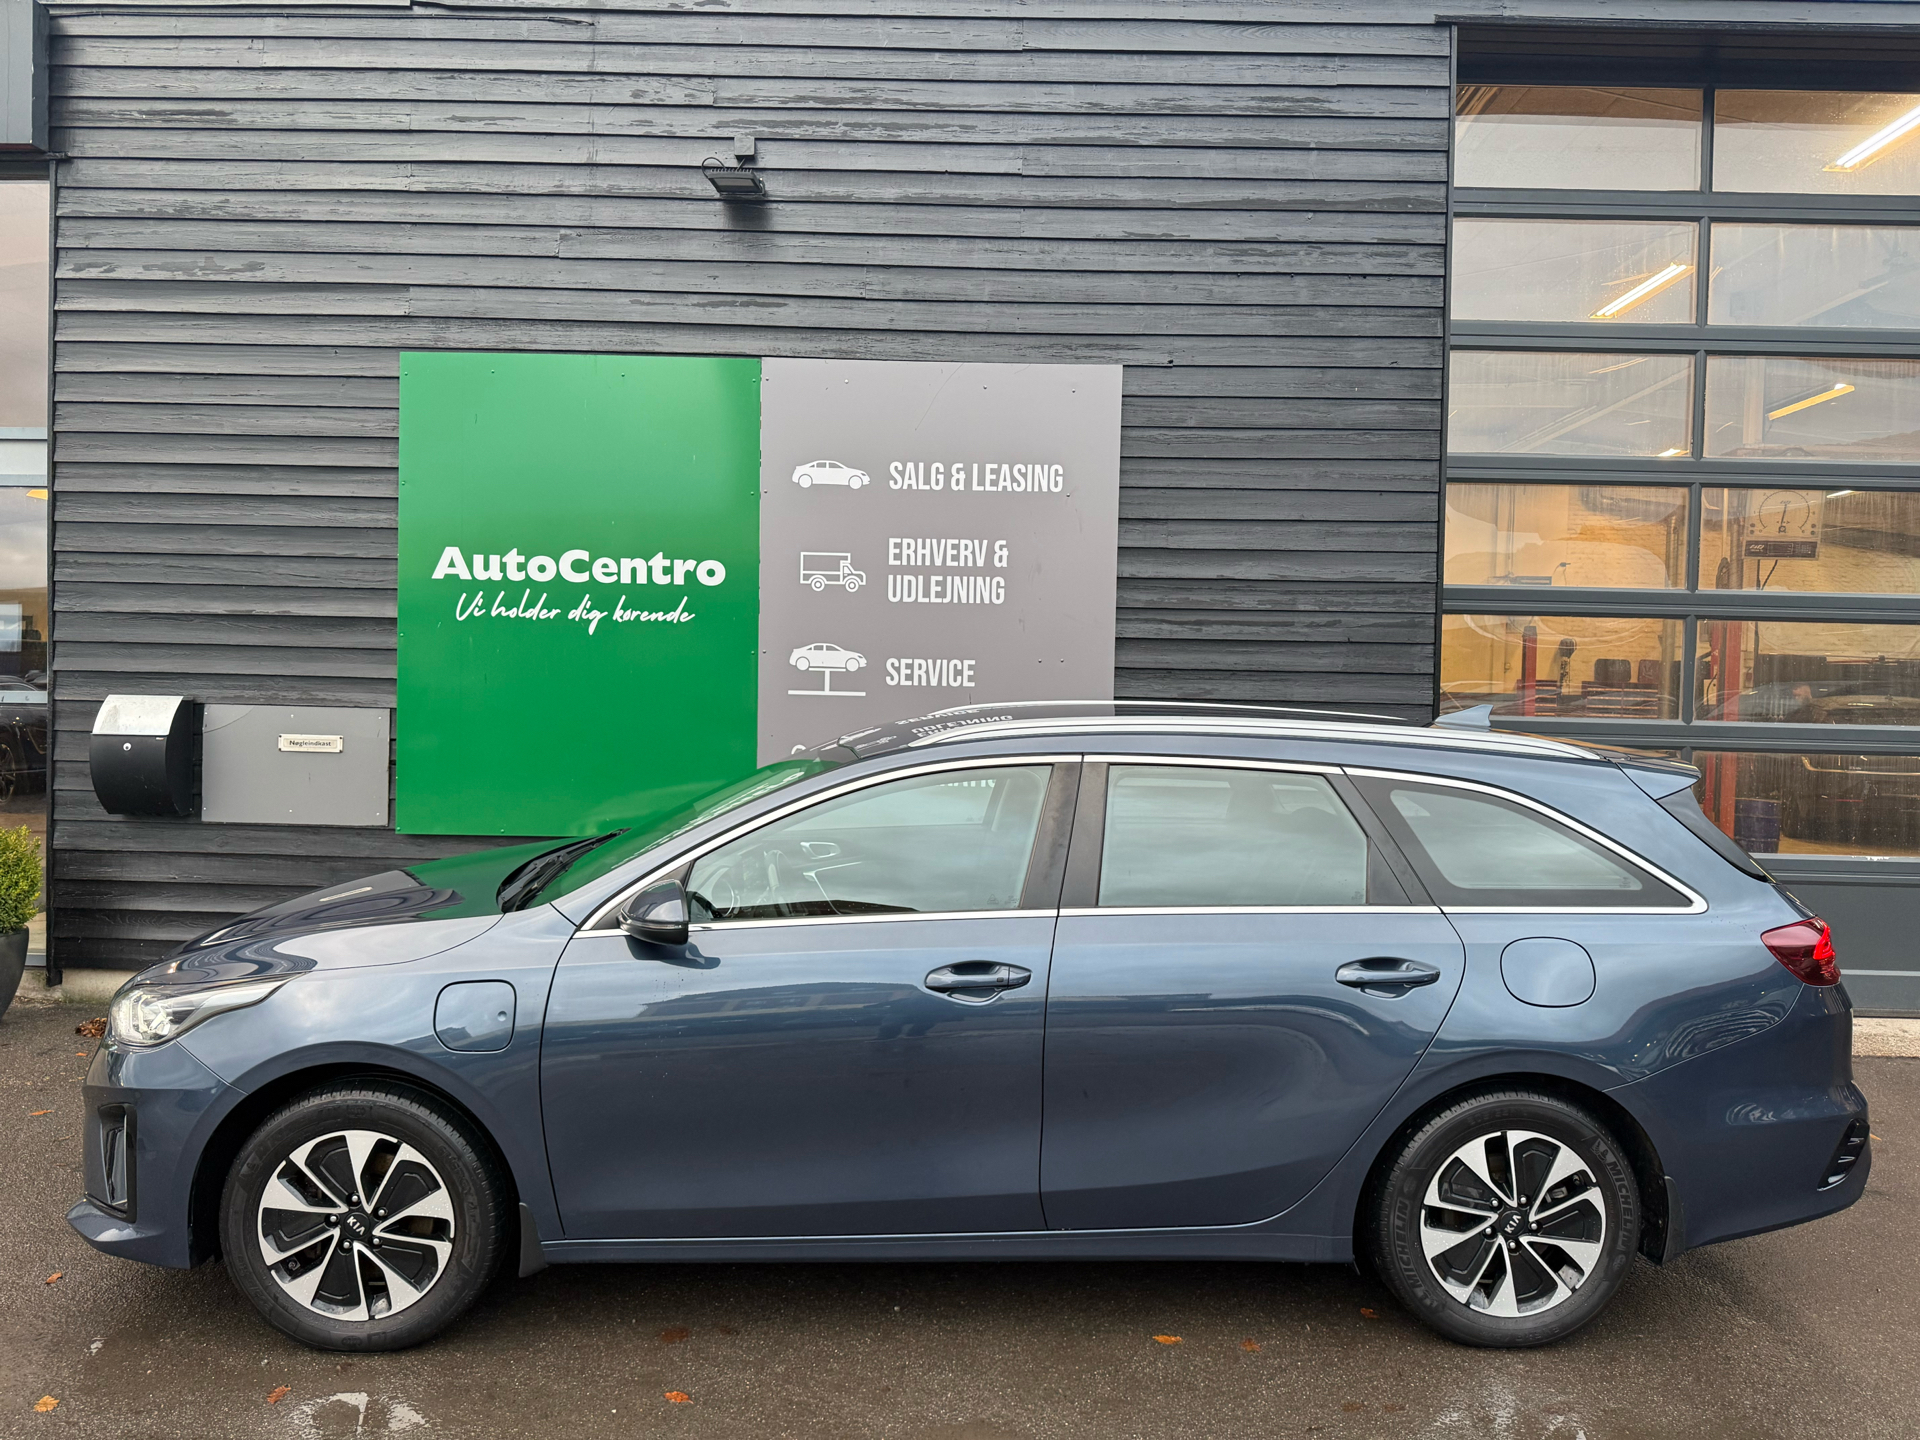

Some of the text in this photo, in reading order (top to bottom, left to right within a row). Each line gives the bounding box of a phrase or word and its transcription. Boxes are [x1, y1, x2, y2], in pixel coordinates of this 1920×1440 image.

[889, 461, 1063, 492] SALG & LEASING
[431, 546, 727, 586] AutoCentro
[888, 538, 1009, 567] ERHVERV &
[887, 575, 1005, 604] UDLEJNING
[456, 588, 695, 636] Vi holder dig kørende
[886, 658, 976, 687] SERVICE
[1607, 1160, 1633, 1251] MICHELIN
[347, 1216, 365, 1235] KIA
[1504, 1214, 1521, 1233] KIA
[1396, 1199, 1423, 1290] MICHELIN
